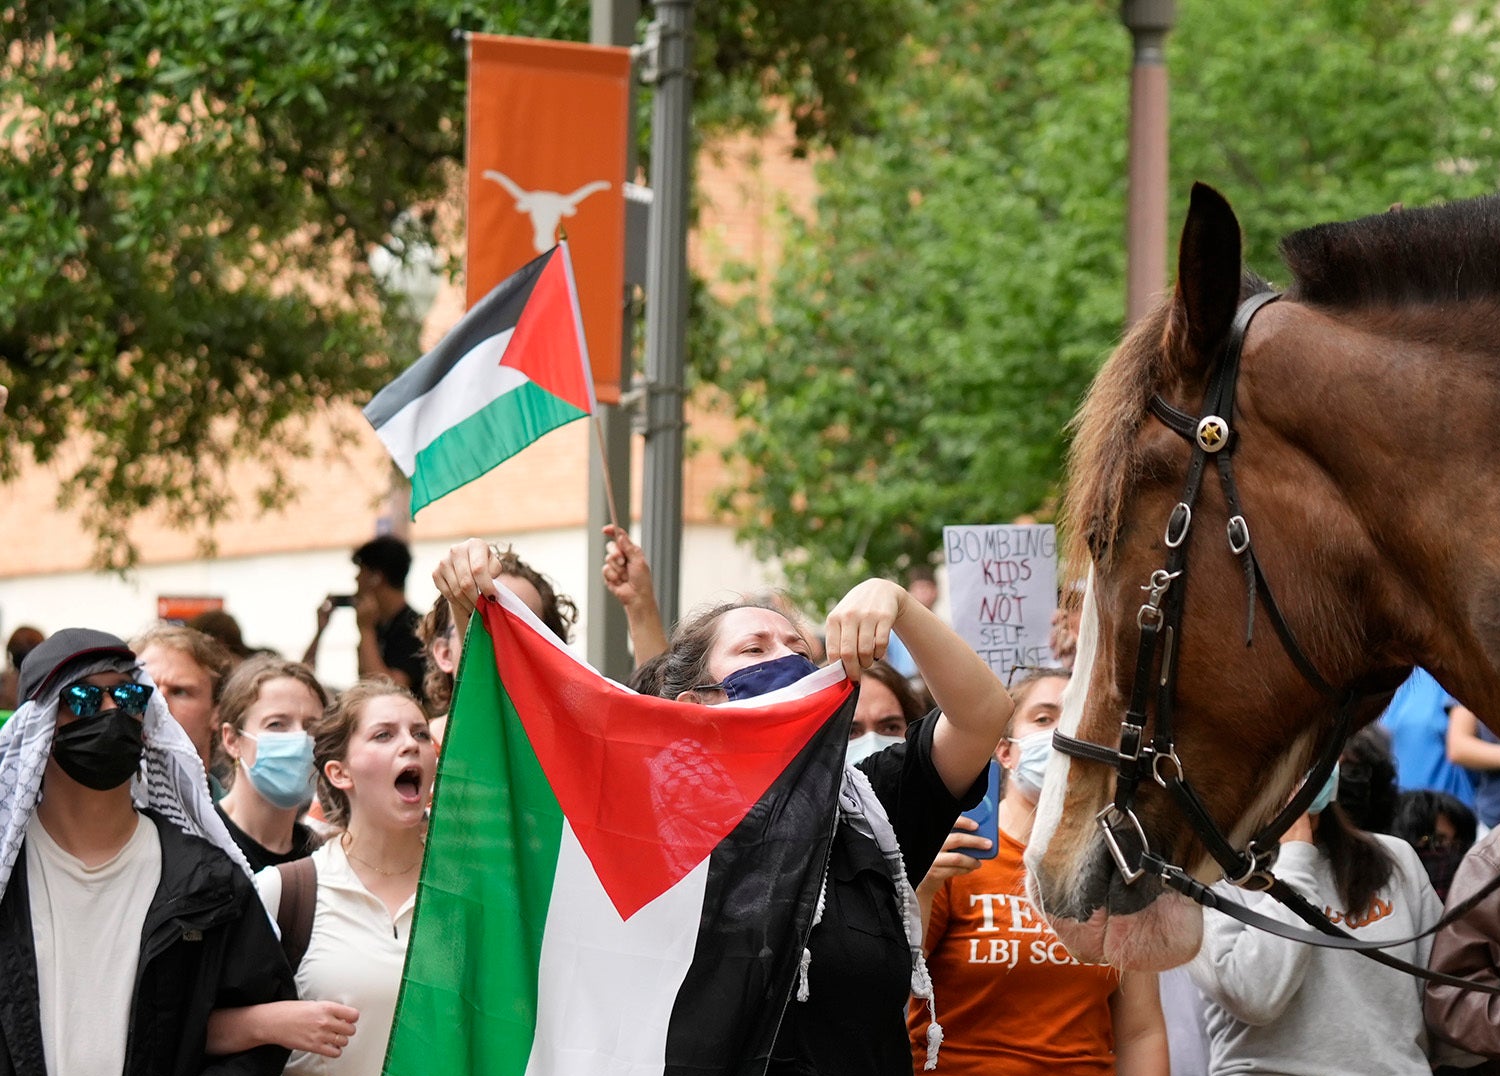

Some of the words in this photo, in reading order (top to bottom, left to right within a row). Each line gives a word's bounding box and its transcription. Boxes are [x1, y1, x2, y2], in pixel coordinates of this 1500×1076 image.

[947, 528, 1056, 564] BOMBING
[981, 559, 1032, 585] KIDS
[996, 583, 1019, 597] IS
[979, 595, 1028, 624] NOT
[970, 893, 1056, 933] TE
[968, 939, 1021, 969] LBJ
